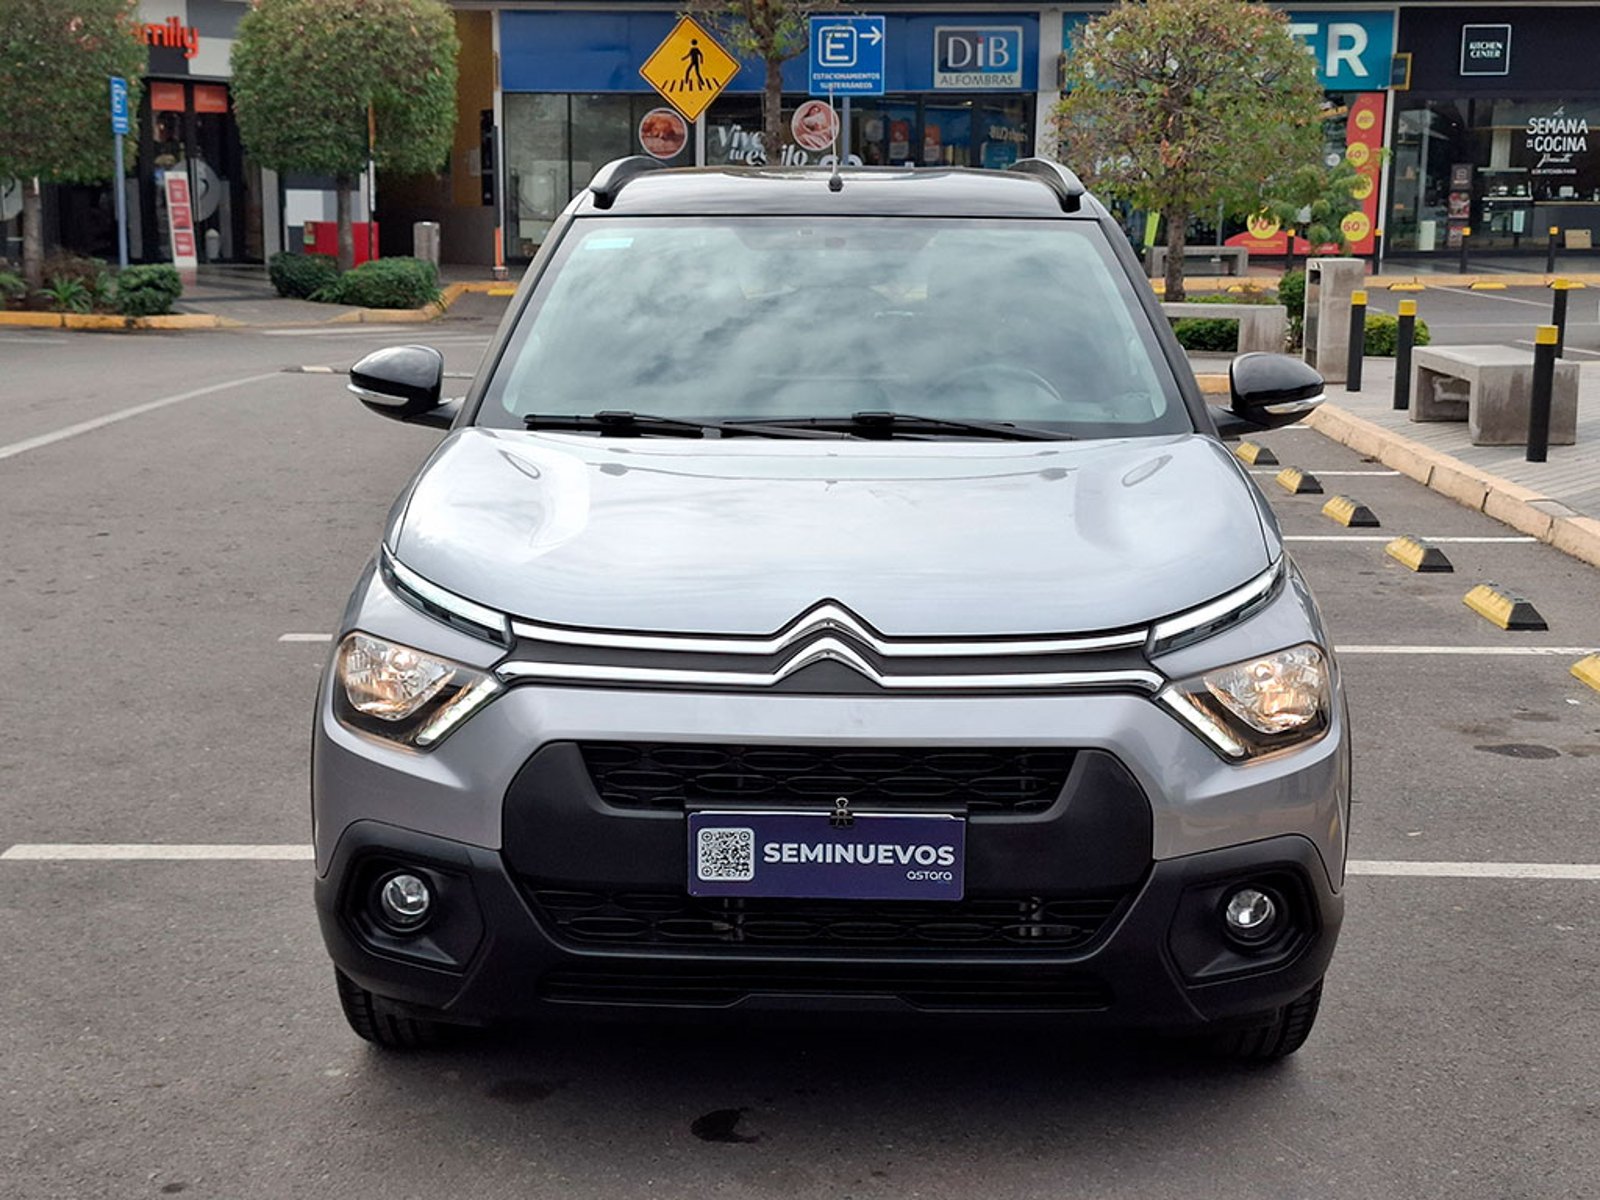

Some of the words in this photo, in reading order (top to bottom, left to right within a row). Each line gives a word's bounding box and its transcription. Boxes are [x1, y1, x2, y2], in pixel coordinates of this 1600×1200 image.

[947, 36, 1009, 68] DiB
[940, 74, 1014, 86] ALFOMBRAS
[1526, 117, 1588, 135] SEMANA
[1534, 136, 1587, 152] COCINA
[763, 843, 955, 866] SEMINUEVOS
